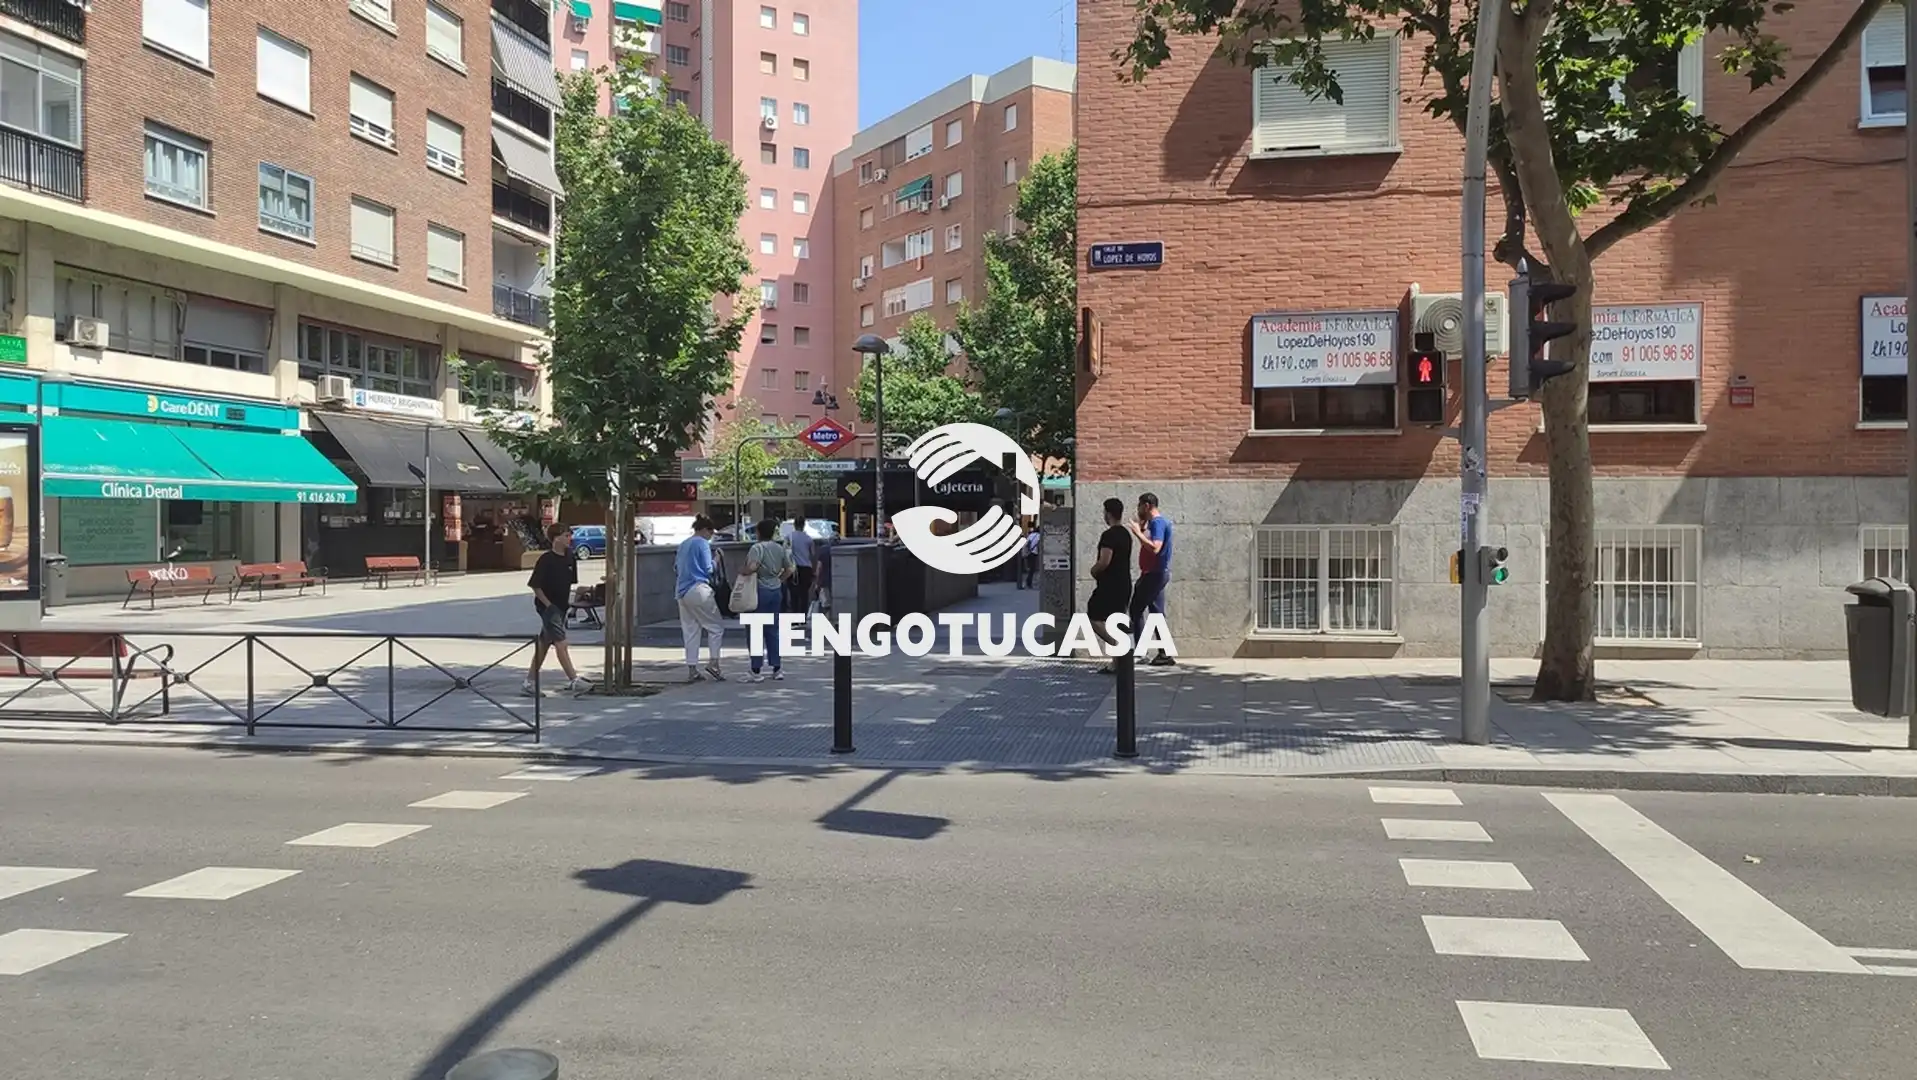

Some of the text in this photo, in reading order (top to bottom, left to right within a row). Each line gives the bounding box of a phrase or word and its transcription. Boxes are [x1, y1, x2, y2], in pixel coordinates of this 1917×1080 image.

[1125, 253, 1134, 262] DE
[1137, 252, 1157, 262] HOYOS
[1871, 301, 1908, 316] Acad
[1260, 317, 1321, 333] Academia
[1277, 333, 1376, 350] LopezDeHoyos190
[1589, 325, 1676, 343] ezDeHoyos190
[1327, 353, 1339, 368] 91
[1342, 352, 1361, 367] 005
[1364, 352, 1377, 367] 96
[1380, 351, 1393, 366] 58
[1622, 346, 1635, 362] 91
[1640, 345, 1660, 361] 005
[1663, 345, 1677, 361] 96
[1681, 344, 1695, 360] 58
[160, 400, 220, 417] CareDENT
[812, 432, 838, 440] Metro
[102, 482, 183, 499] Clínica Dental
[297, 491, 306, 502] 91
